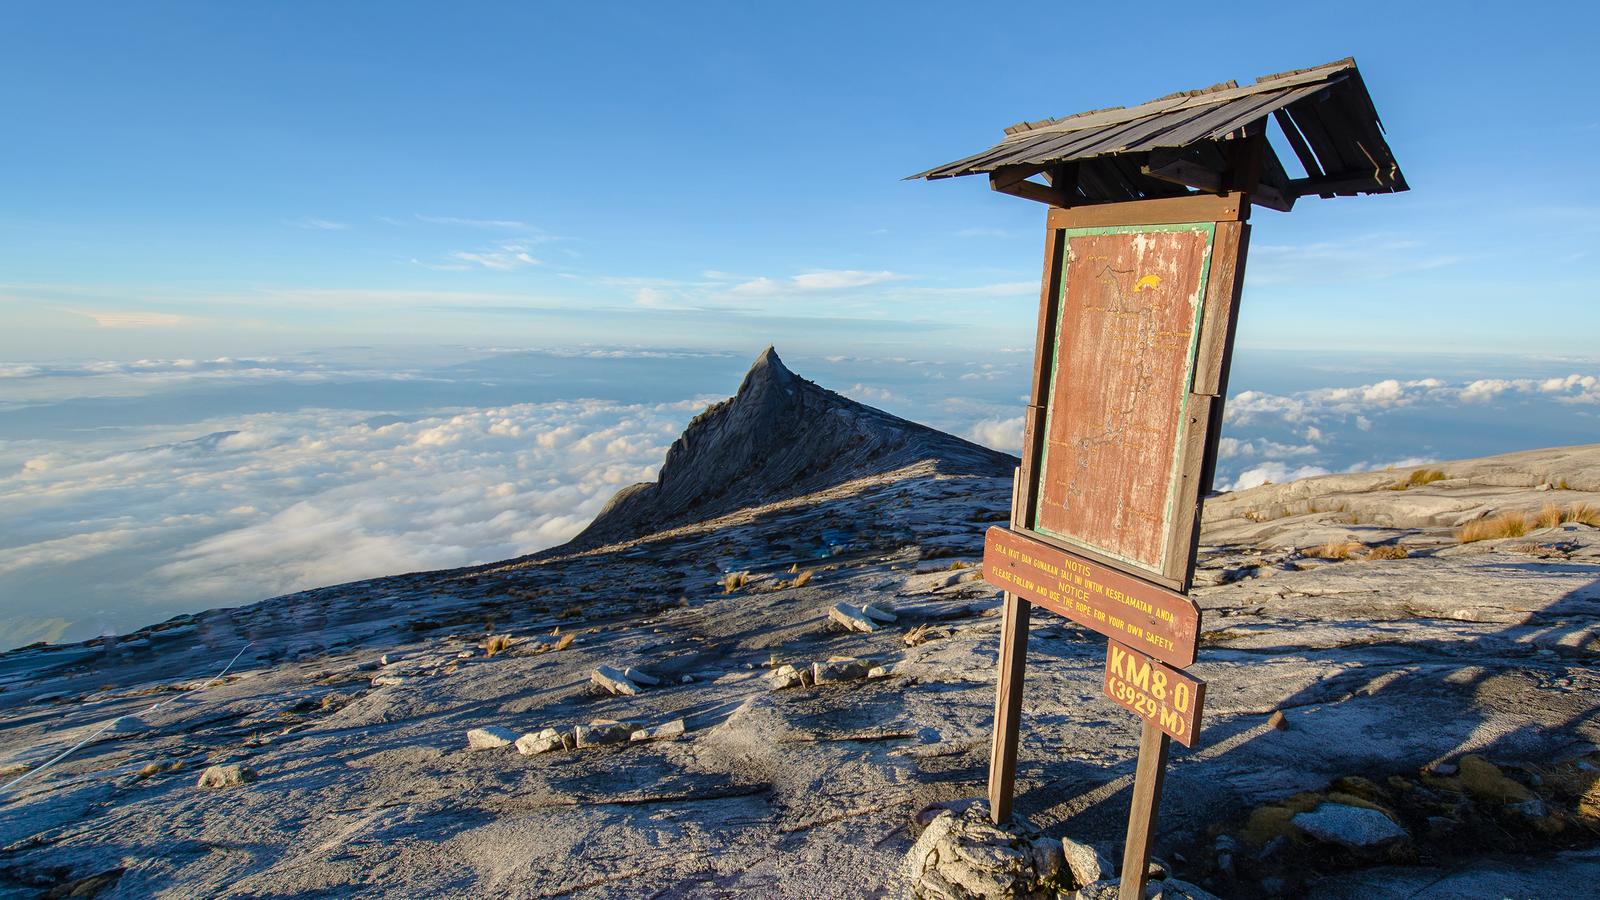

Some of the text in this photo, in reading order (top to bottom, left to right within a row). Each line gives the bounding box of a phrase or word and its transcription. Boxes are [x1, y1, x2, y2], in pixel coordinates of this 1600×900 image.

[995, 543, 1006, 555] SILA
[1022, 553, 1032, 565] DAN
[1033, 558, 1059, 576] GUNAKAN
[1060, 569, 1073, 582] TALI
[1085, 579, 1104, 594] UNTUK
[1105, 587, 1153, 615] KESELAMATAN
[1155, 607, 1175, 624] ANDA
[1058, 582, 1090, 603] NOTICE
[1065, 560, 1091, 577] NOTIS
[992, 566, 1175, 653] PLEASE FOLLOW AND USE THE ROPE FOR YOUR OWN SAFETY.
